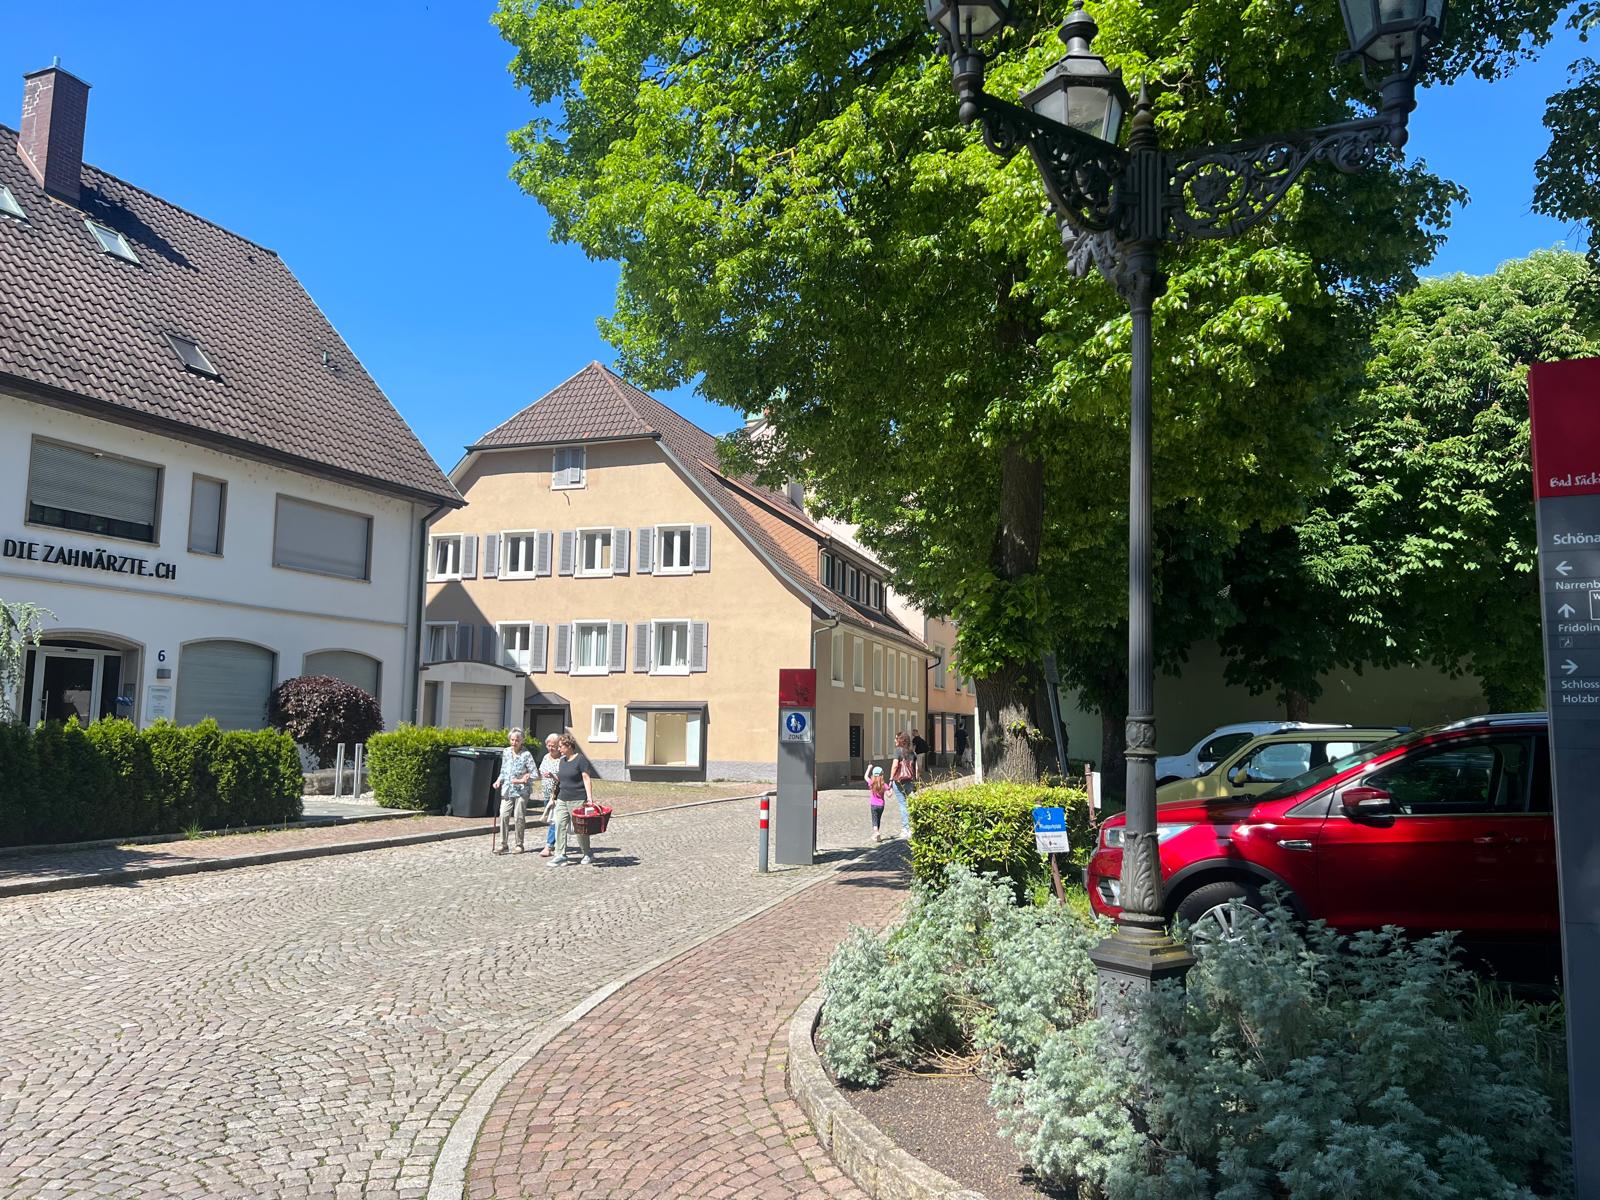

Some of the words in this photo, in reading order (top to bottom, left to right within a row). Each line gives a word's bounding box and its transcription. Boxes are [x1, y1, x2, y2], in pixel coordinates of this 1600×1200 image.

[1549, 474, 1572, 488] Bad
[3, 538, 40, 561] DIE
[42, 544, 177, 580] ZAHNÄRZTE.CH
[1558, 623, 1600, 633] Fridolin
[157, 649, 166, 662] 6
[1561, 680, 1600, 690] Schloss
